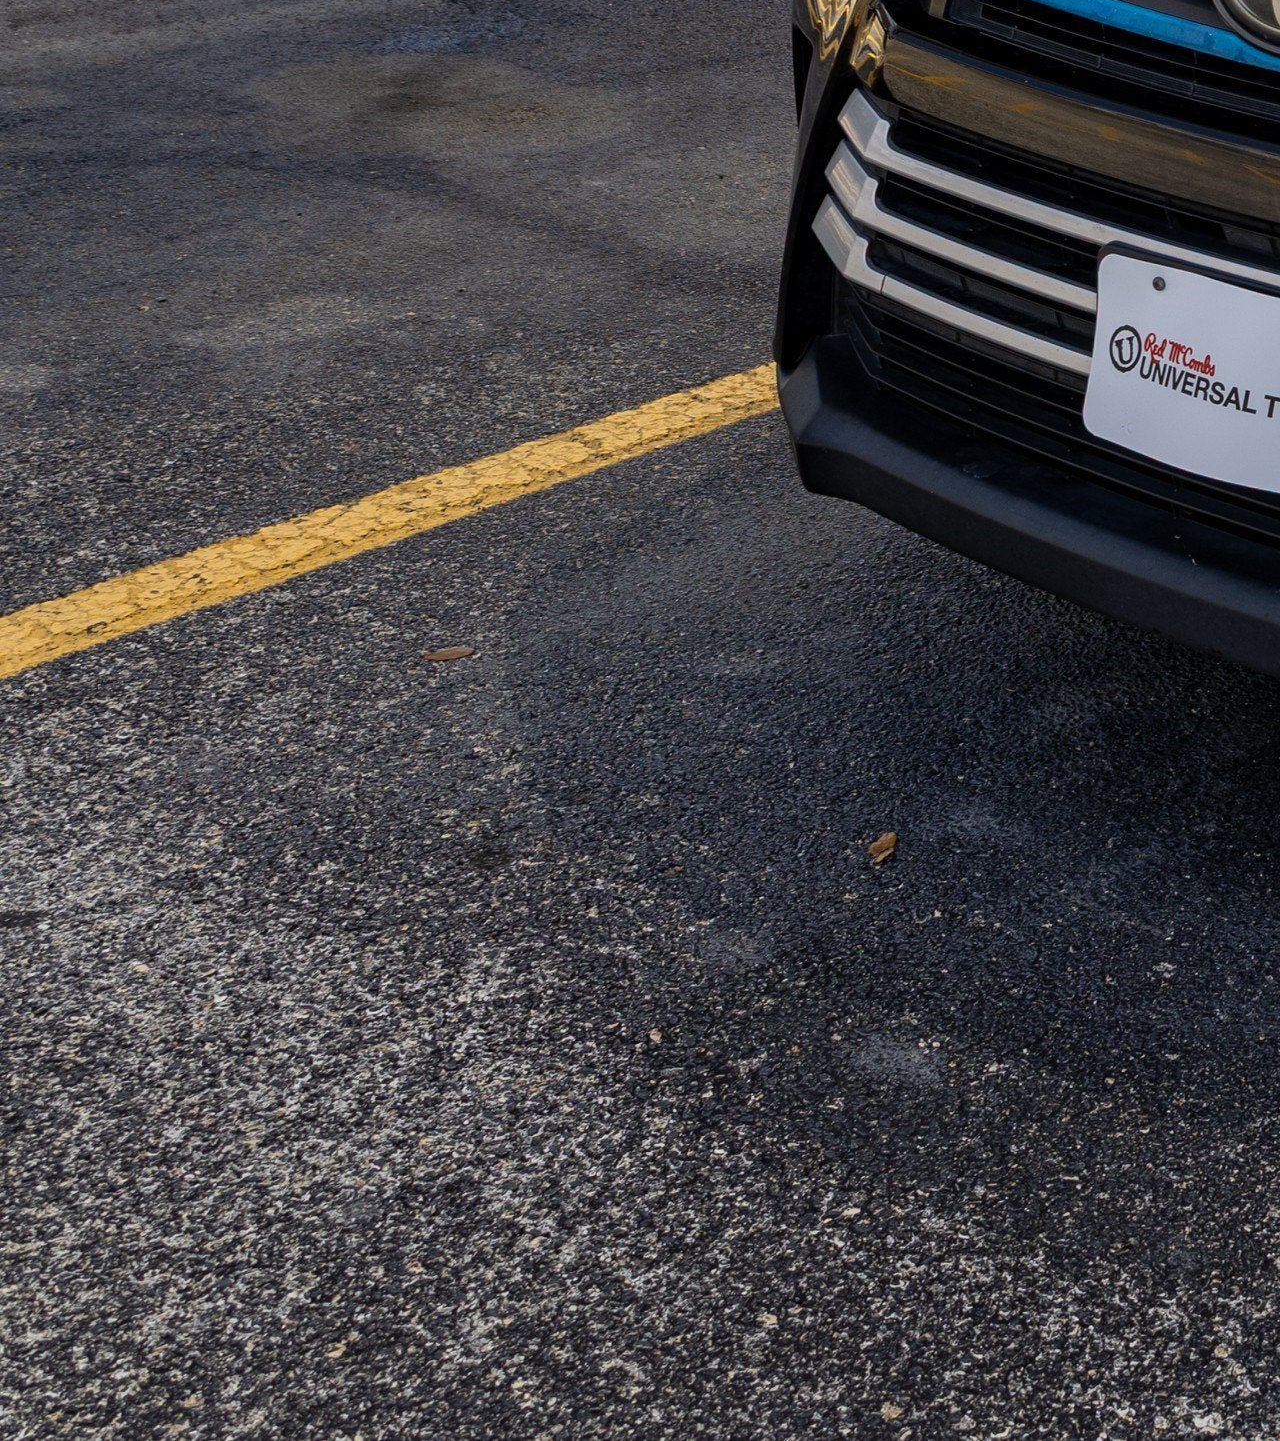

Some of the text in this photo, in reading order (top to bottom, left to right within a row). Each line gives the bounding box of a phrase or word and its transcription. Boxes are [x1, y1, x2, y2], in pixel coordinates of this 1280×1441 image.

[1144, 333, 1215, 377] Red McCombs
[1140, 356, 1257, 414] UNIVERSAL
